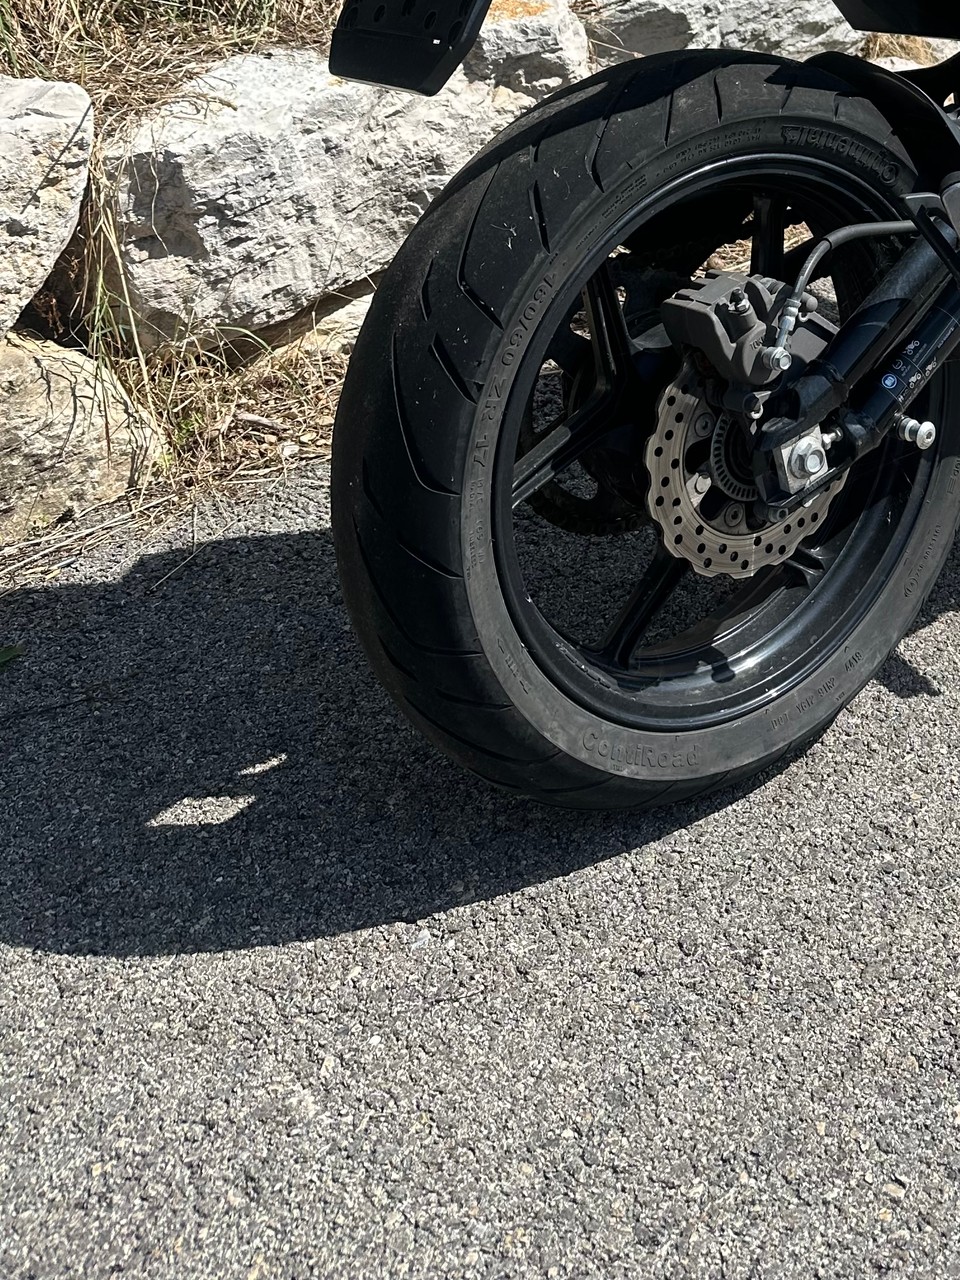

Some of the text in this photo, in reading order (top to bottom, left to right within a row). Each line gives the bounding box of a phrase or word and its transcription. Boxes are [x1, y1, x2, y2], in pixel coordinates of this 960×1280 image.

[796, 125, 901, 186] Continental
[499, 272, 557, 367] 160/60
[481, 374, 507, 422] ZR
[472, 434, 491, 469] 17
[581, 726, 703, 769] ContiRoad
